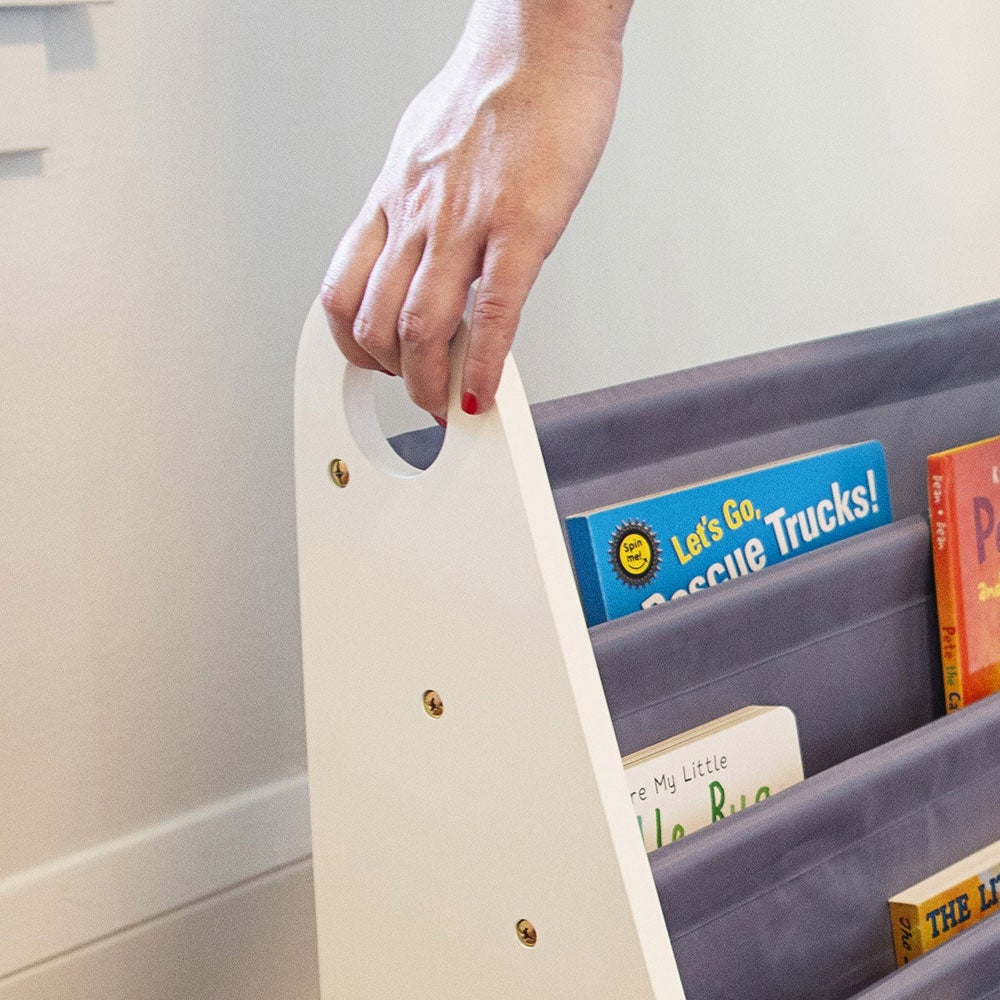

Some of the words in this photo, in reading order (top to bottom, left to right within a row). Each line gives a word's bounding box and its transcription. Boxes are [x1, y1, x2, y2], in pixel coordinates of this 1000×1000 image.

[670, 515, 724, 566] Let's
[722, 498, 762, 531] Go,
[765, 469, 880, 556] Trucks!
[623, 538, 643, 553] Spin
[653, 773, 677, 795] My
[682, 754, 728, 783] Little
[925, 893, 972, 939] THE
